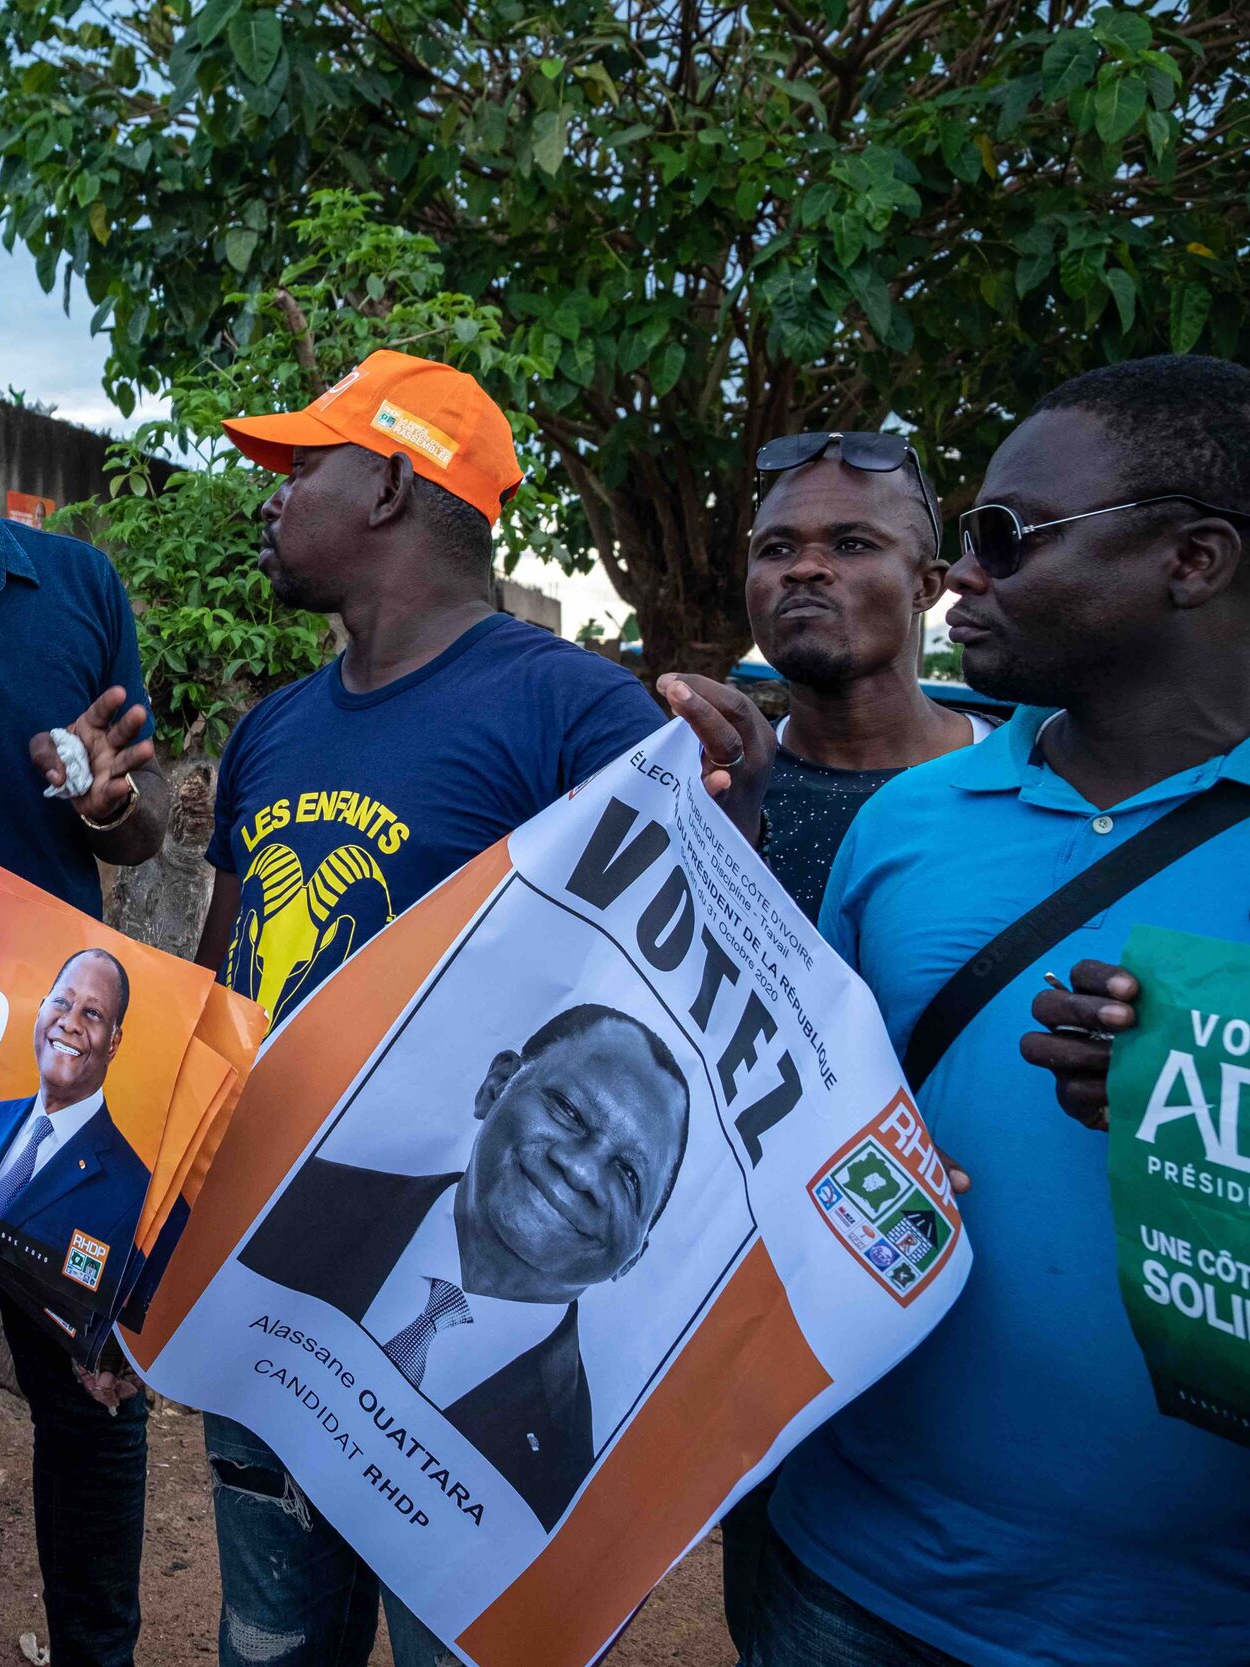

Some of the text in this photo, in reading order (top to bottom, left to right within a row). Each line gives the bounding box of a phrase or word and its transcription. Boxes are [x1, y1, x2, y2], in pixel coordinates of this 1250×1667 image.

[240, 790, 410, 855] LES ENFANTS
[630, 749, 682, 819] ÉLECT
[686, 840, 742, 928] PRÉSIDENT
[742, 925, 762, 954] DE
[761, 951, 778, 980] LA
[779, 974, 838, 1092] RÉPUBLIQUE
[688, 813, 706, 850] Union
[710, 855, 752, 911] Discipline
[759, 914, 790, 960] Travail
[697, 886, 708, 904] du
[706, 905, 717, 922] 31
[718, 920, 755, 971] Octobre
[754, 969, 778, 1002] 2020
[725, 852, 740, 876] DE
[741, 871, 770, 912] CÔTE
[770, 909, 814, 972] D'IVOIRE
[565, 795, 804, 1171] VOTEZ
[1147, 1154, 1250, 1206] PRÉSID
[72, 1233, 107, 1258] RHDP
[1140, 1224, 1192, 1268] UNE
[1142, 1258, 1250, 1341] SOLI
[248, 1315, 486, 1528] Alassane OUATTARA
[254, 1360, 430, 1528] CANDIDAT RHDP
